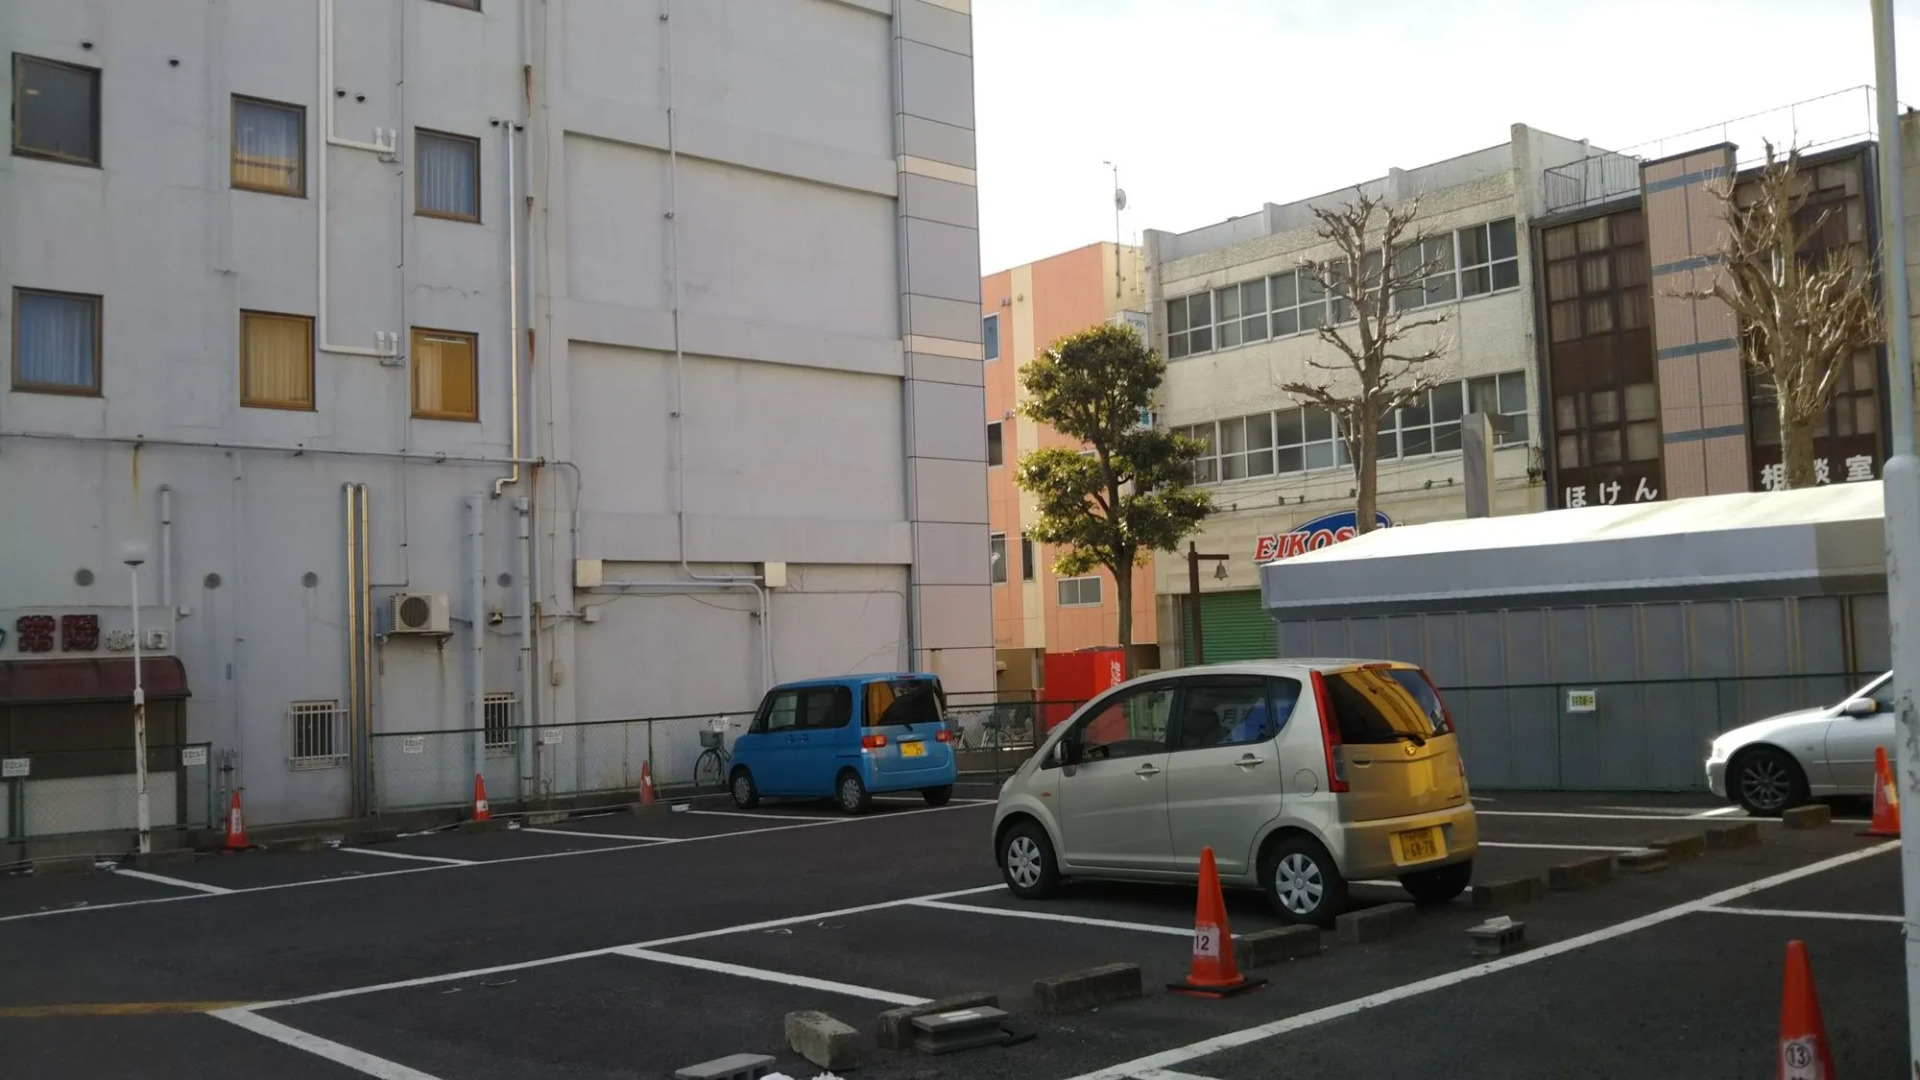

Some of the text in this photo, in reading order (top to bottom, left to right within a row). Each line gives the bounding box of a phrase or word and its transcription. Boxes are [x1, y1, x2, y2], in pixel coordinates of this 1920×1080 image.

[1566, 477, 1657, 508] ほけん
[1253, 525, 1386, 562] EIKOS
[1196, 935, 1210, 951] 12
